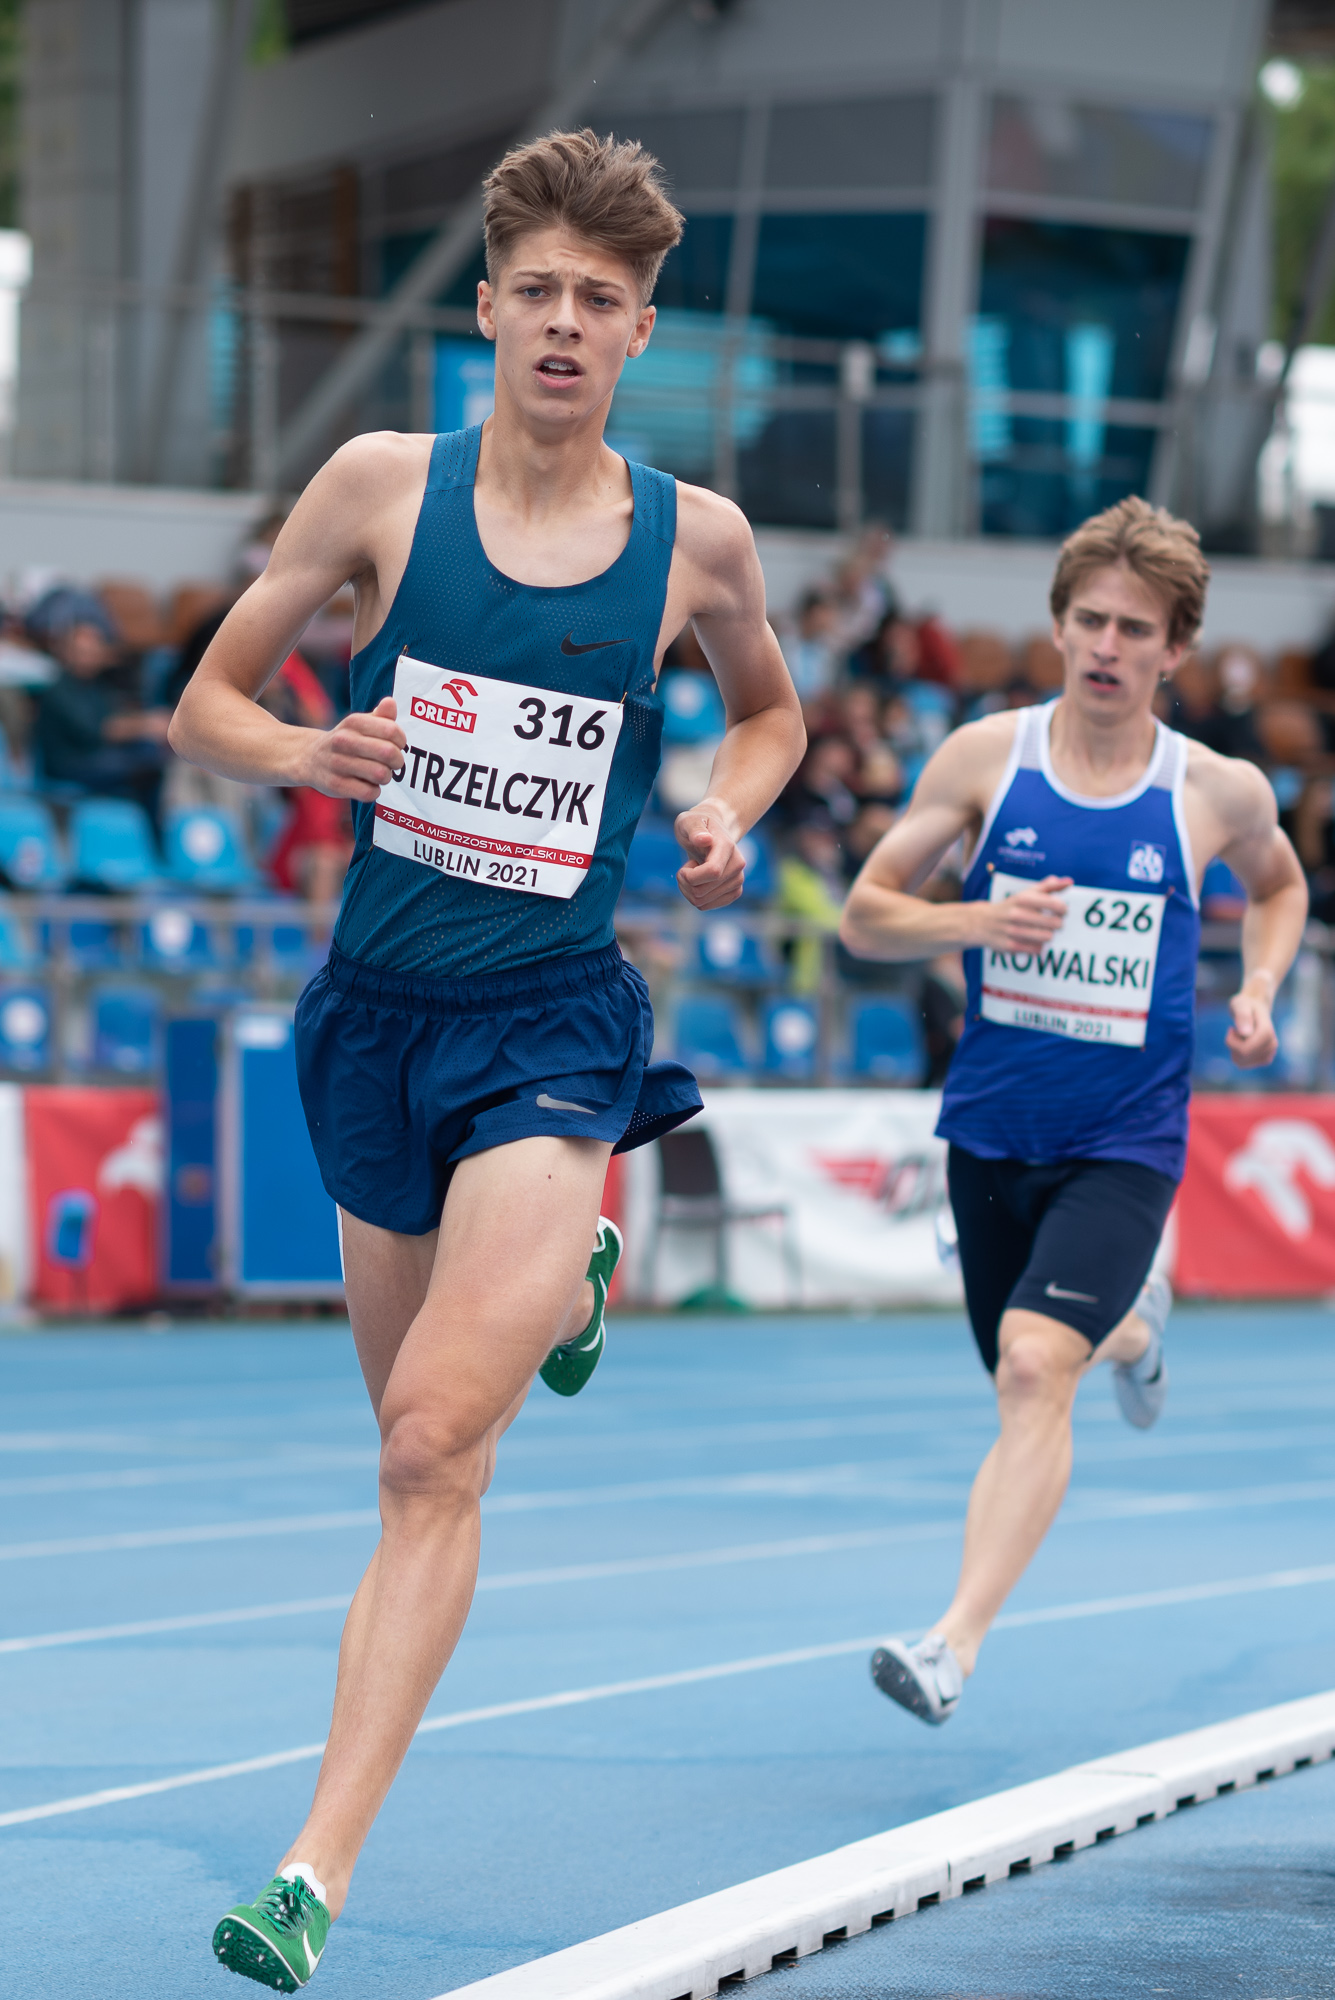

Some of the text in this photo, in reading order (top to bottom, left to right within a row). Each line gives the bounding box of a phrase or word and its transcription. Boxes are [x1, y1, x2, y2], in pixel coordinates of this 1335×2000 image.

[414, 701, 472, 731] ORLEN
[513, 697, 608, 751] 316
[382, 809, 585, 865] 75. PZLA MISTRZOSTWA POLSKI U20
[413, 839, 538, 888] LUBLIN 2021
[1084, 898, 1153, 933] 626
[1013, 1007, 1112, 1038] LUBLIN 2021
